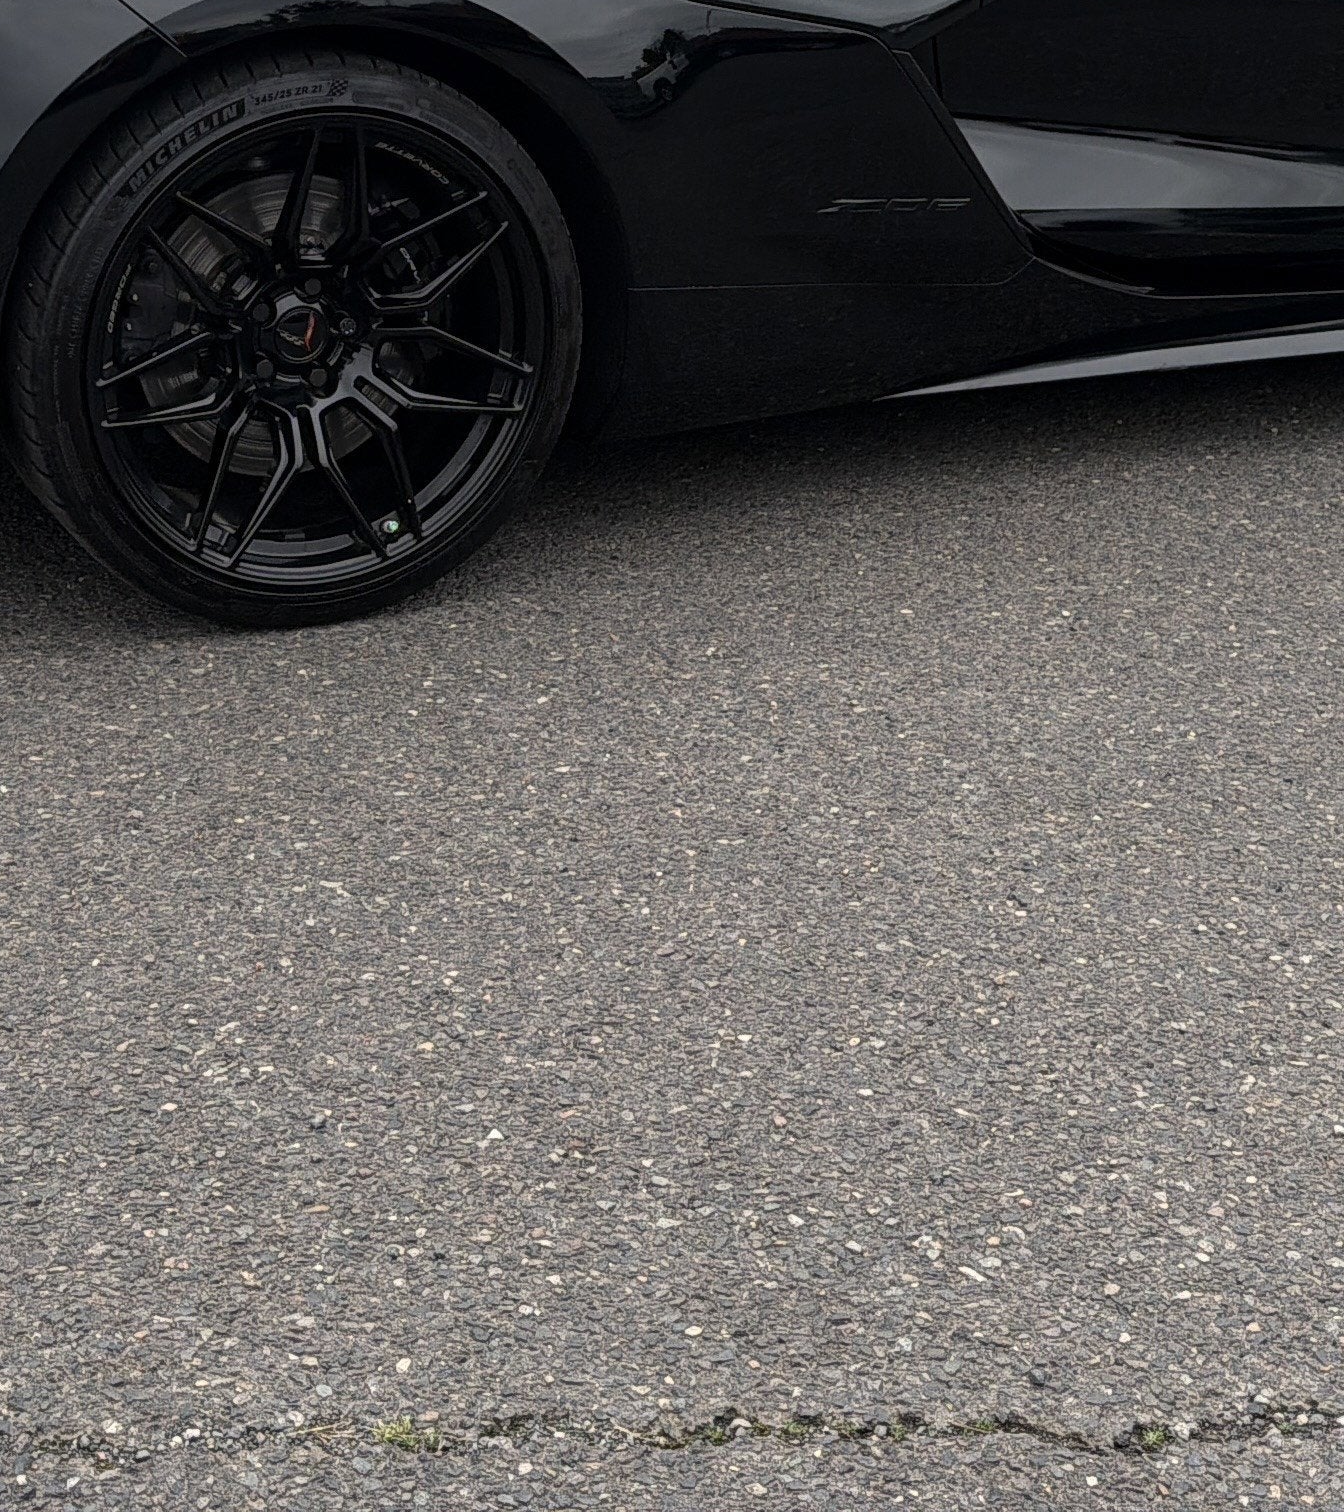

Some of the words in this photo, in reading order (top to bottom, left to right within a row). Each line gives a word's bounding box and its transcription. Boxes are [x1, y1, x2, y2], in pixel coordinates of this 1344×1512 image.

[254, 88, 292, 106] 345/25
[295, 85, 309, 96] ZR
[311, 83, 323, 94] 21
[128, 102, 241, 193] MICHELIN
